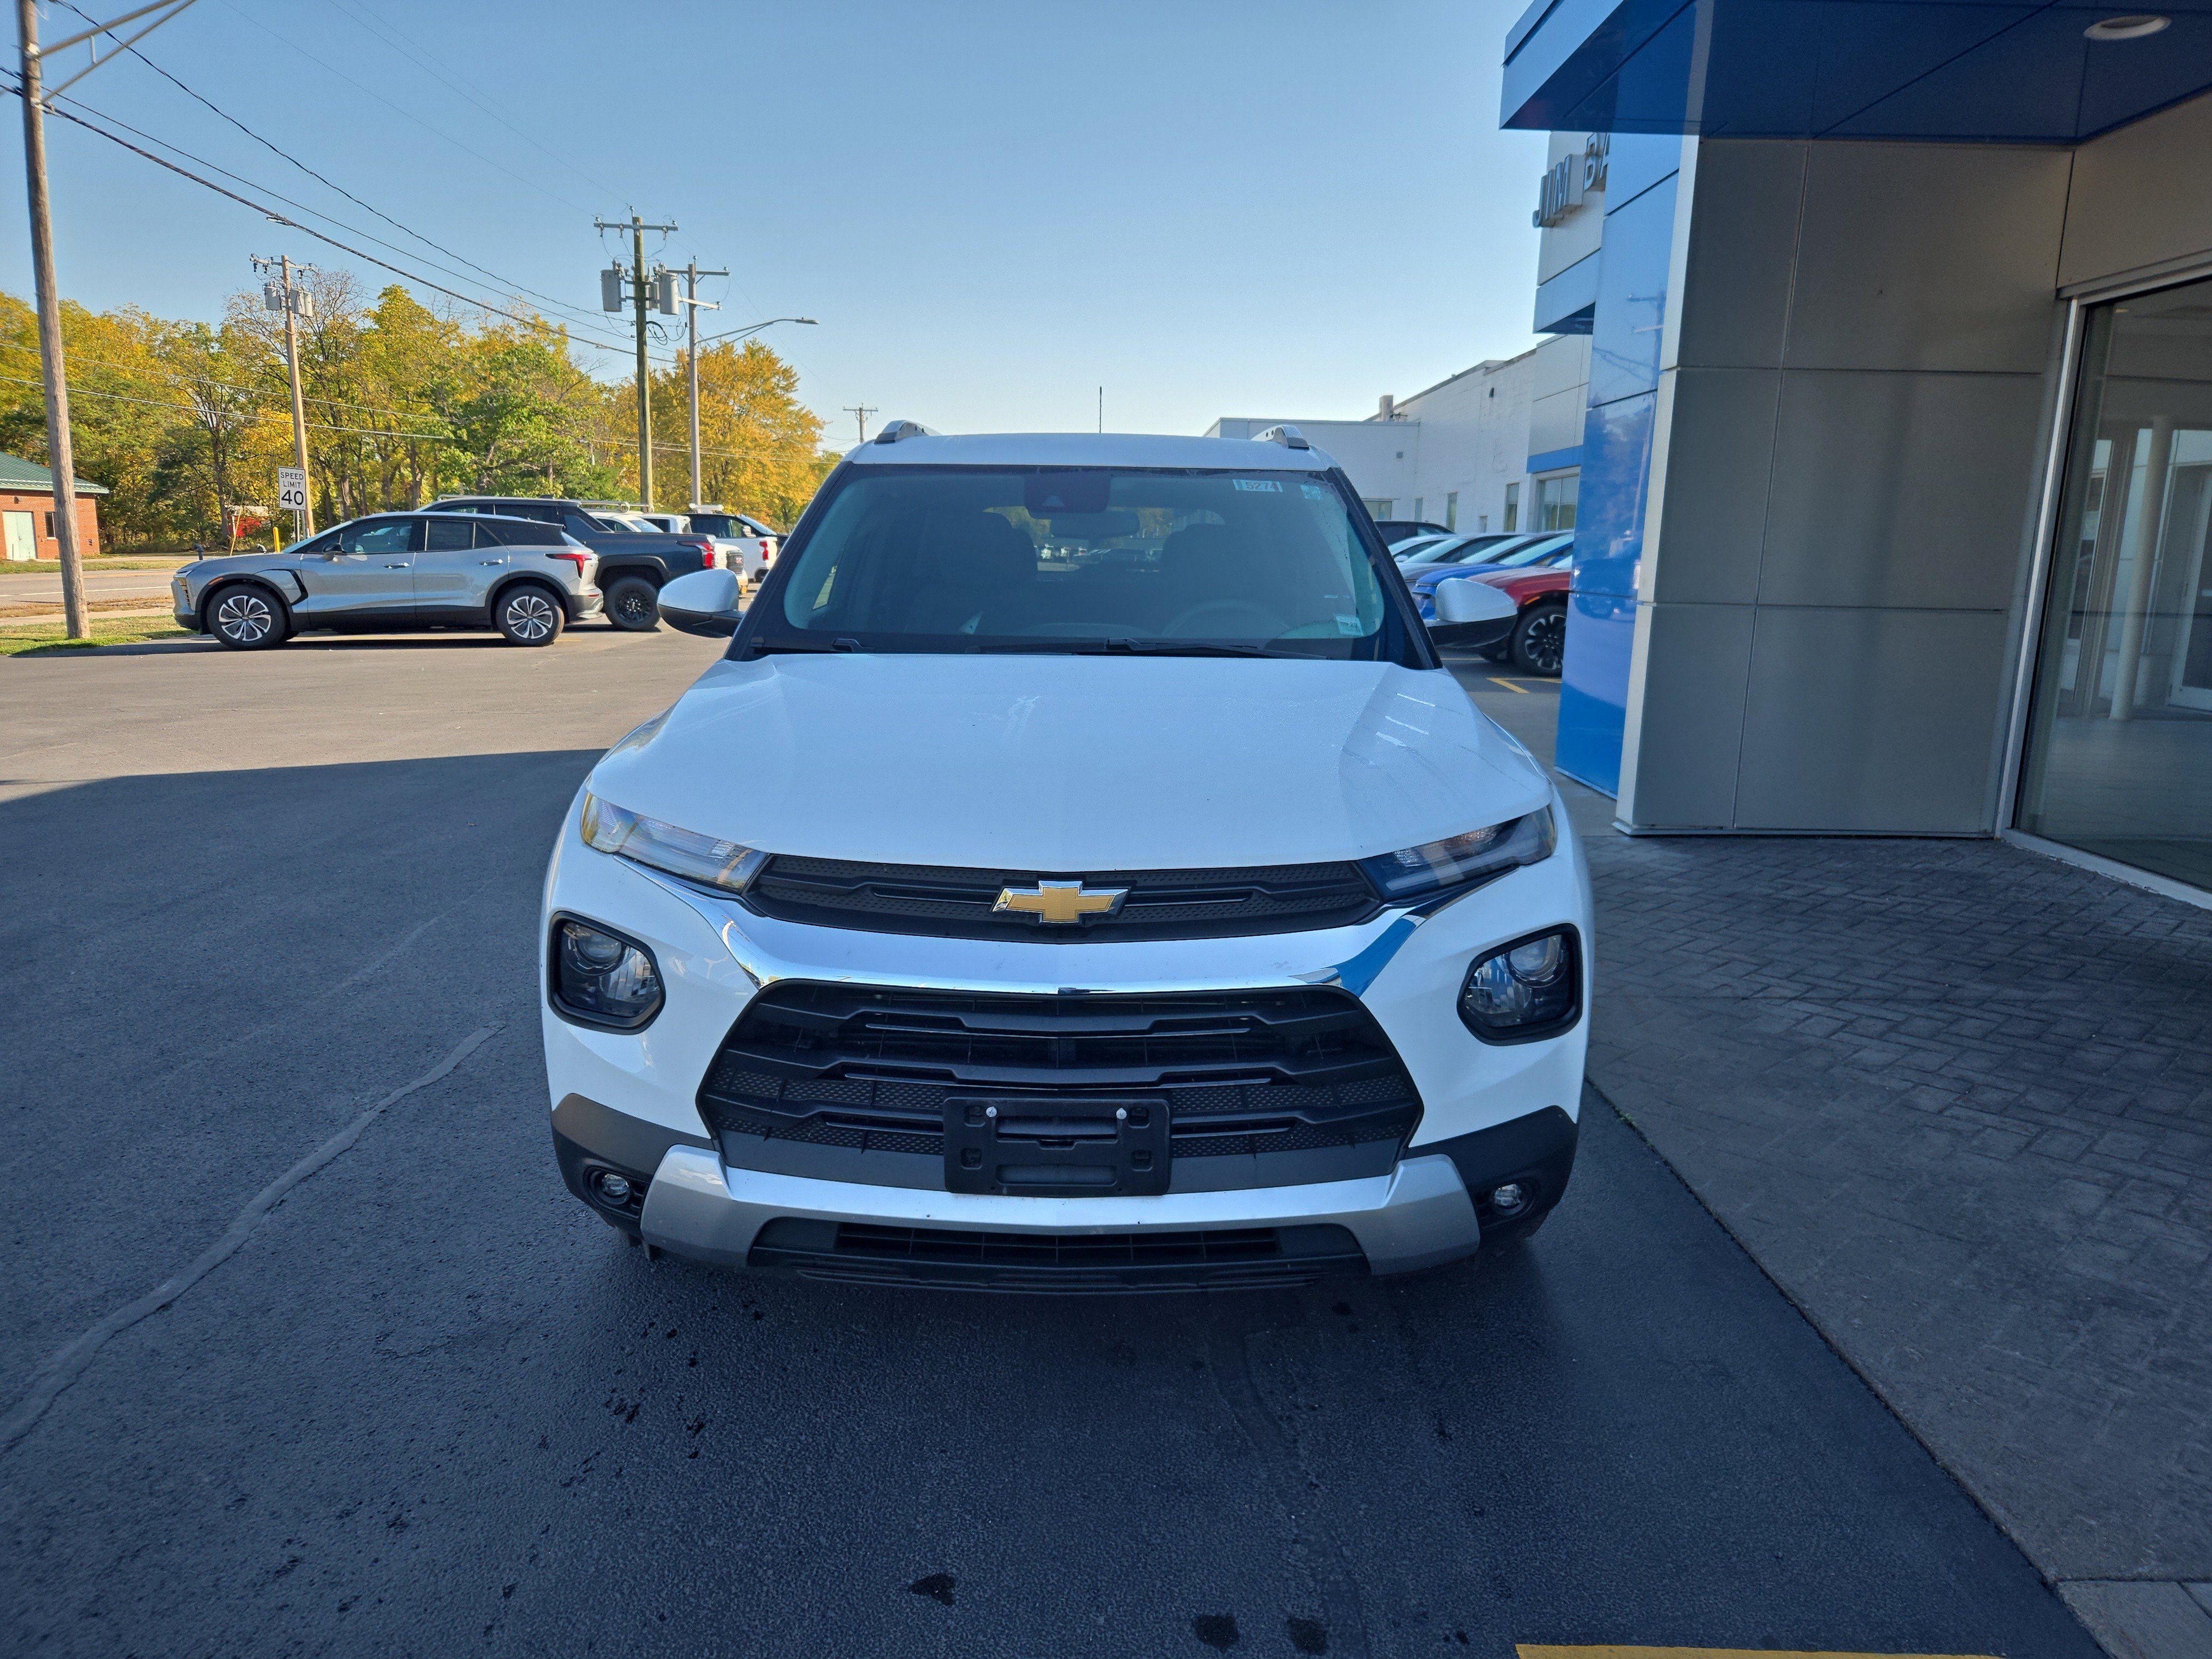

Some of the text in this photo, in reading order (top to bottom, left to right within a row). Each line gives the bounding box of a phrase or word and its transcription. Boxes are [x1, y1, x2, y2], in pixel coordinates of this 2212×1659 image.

[1532, 154, 1576, 228] JIM
[280, 472, 304, 480] SPEED
[283, 480, 301, 488] LIMIT
[281, 490, 304, 506] 40
